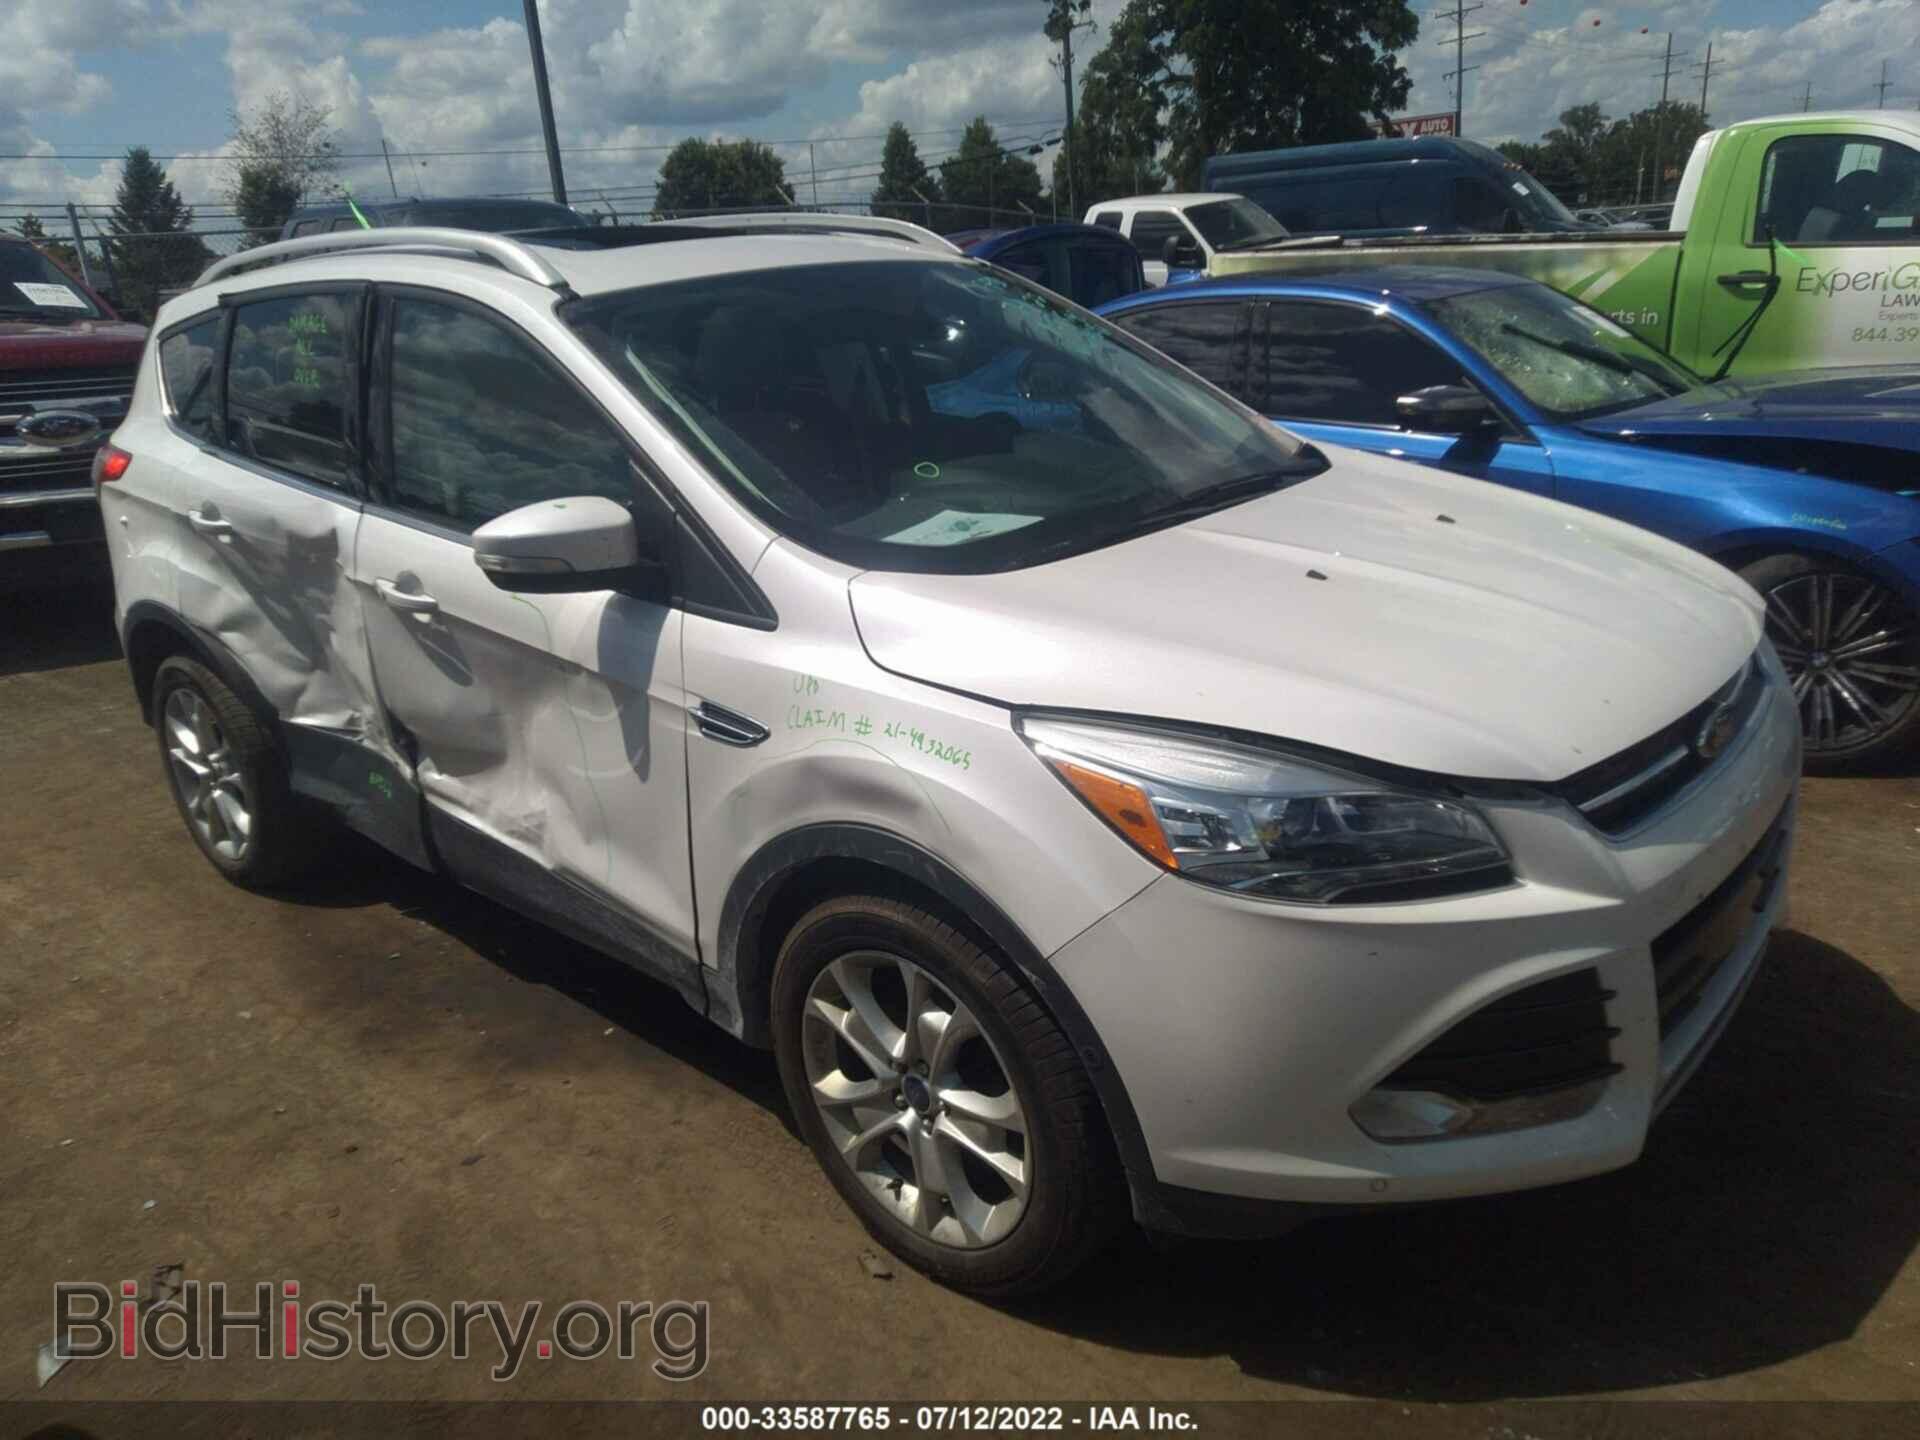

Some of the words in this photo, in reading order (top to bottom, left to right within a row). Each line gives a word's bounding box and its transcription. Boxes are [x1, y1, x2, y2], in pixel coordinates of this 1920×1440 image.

[1420, 118, 1449, 132] AUTO
[1642, 306, 1658, 325] in
[786, 704, 846, 732] CLAIM
[854, 715, 873, 736] #
